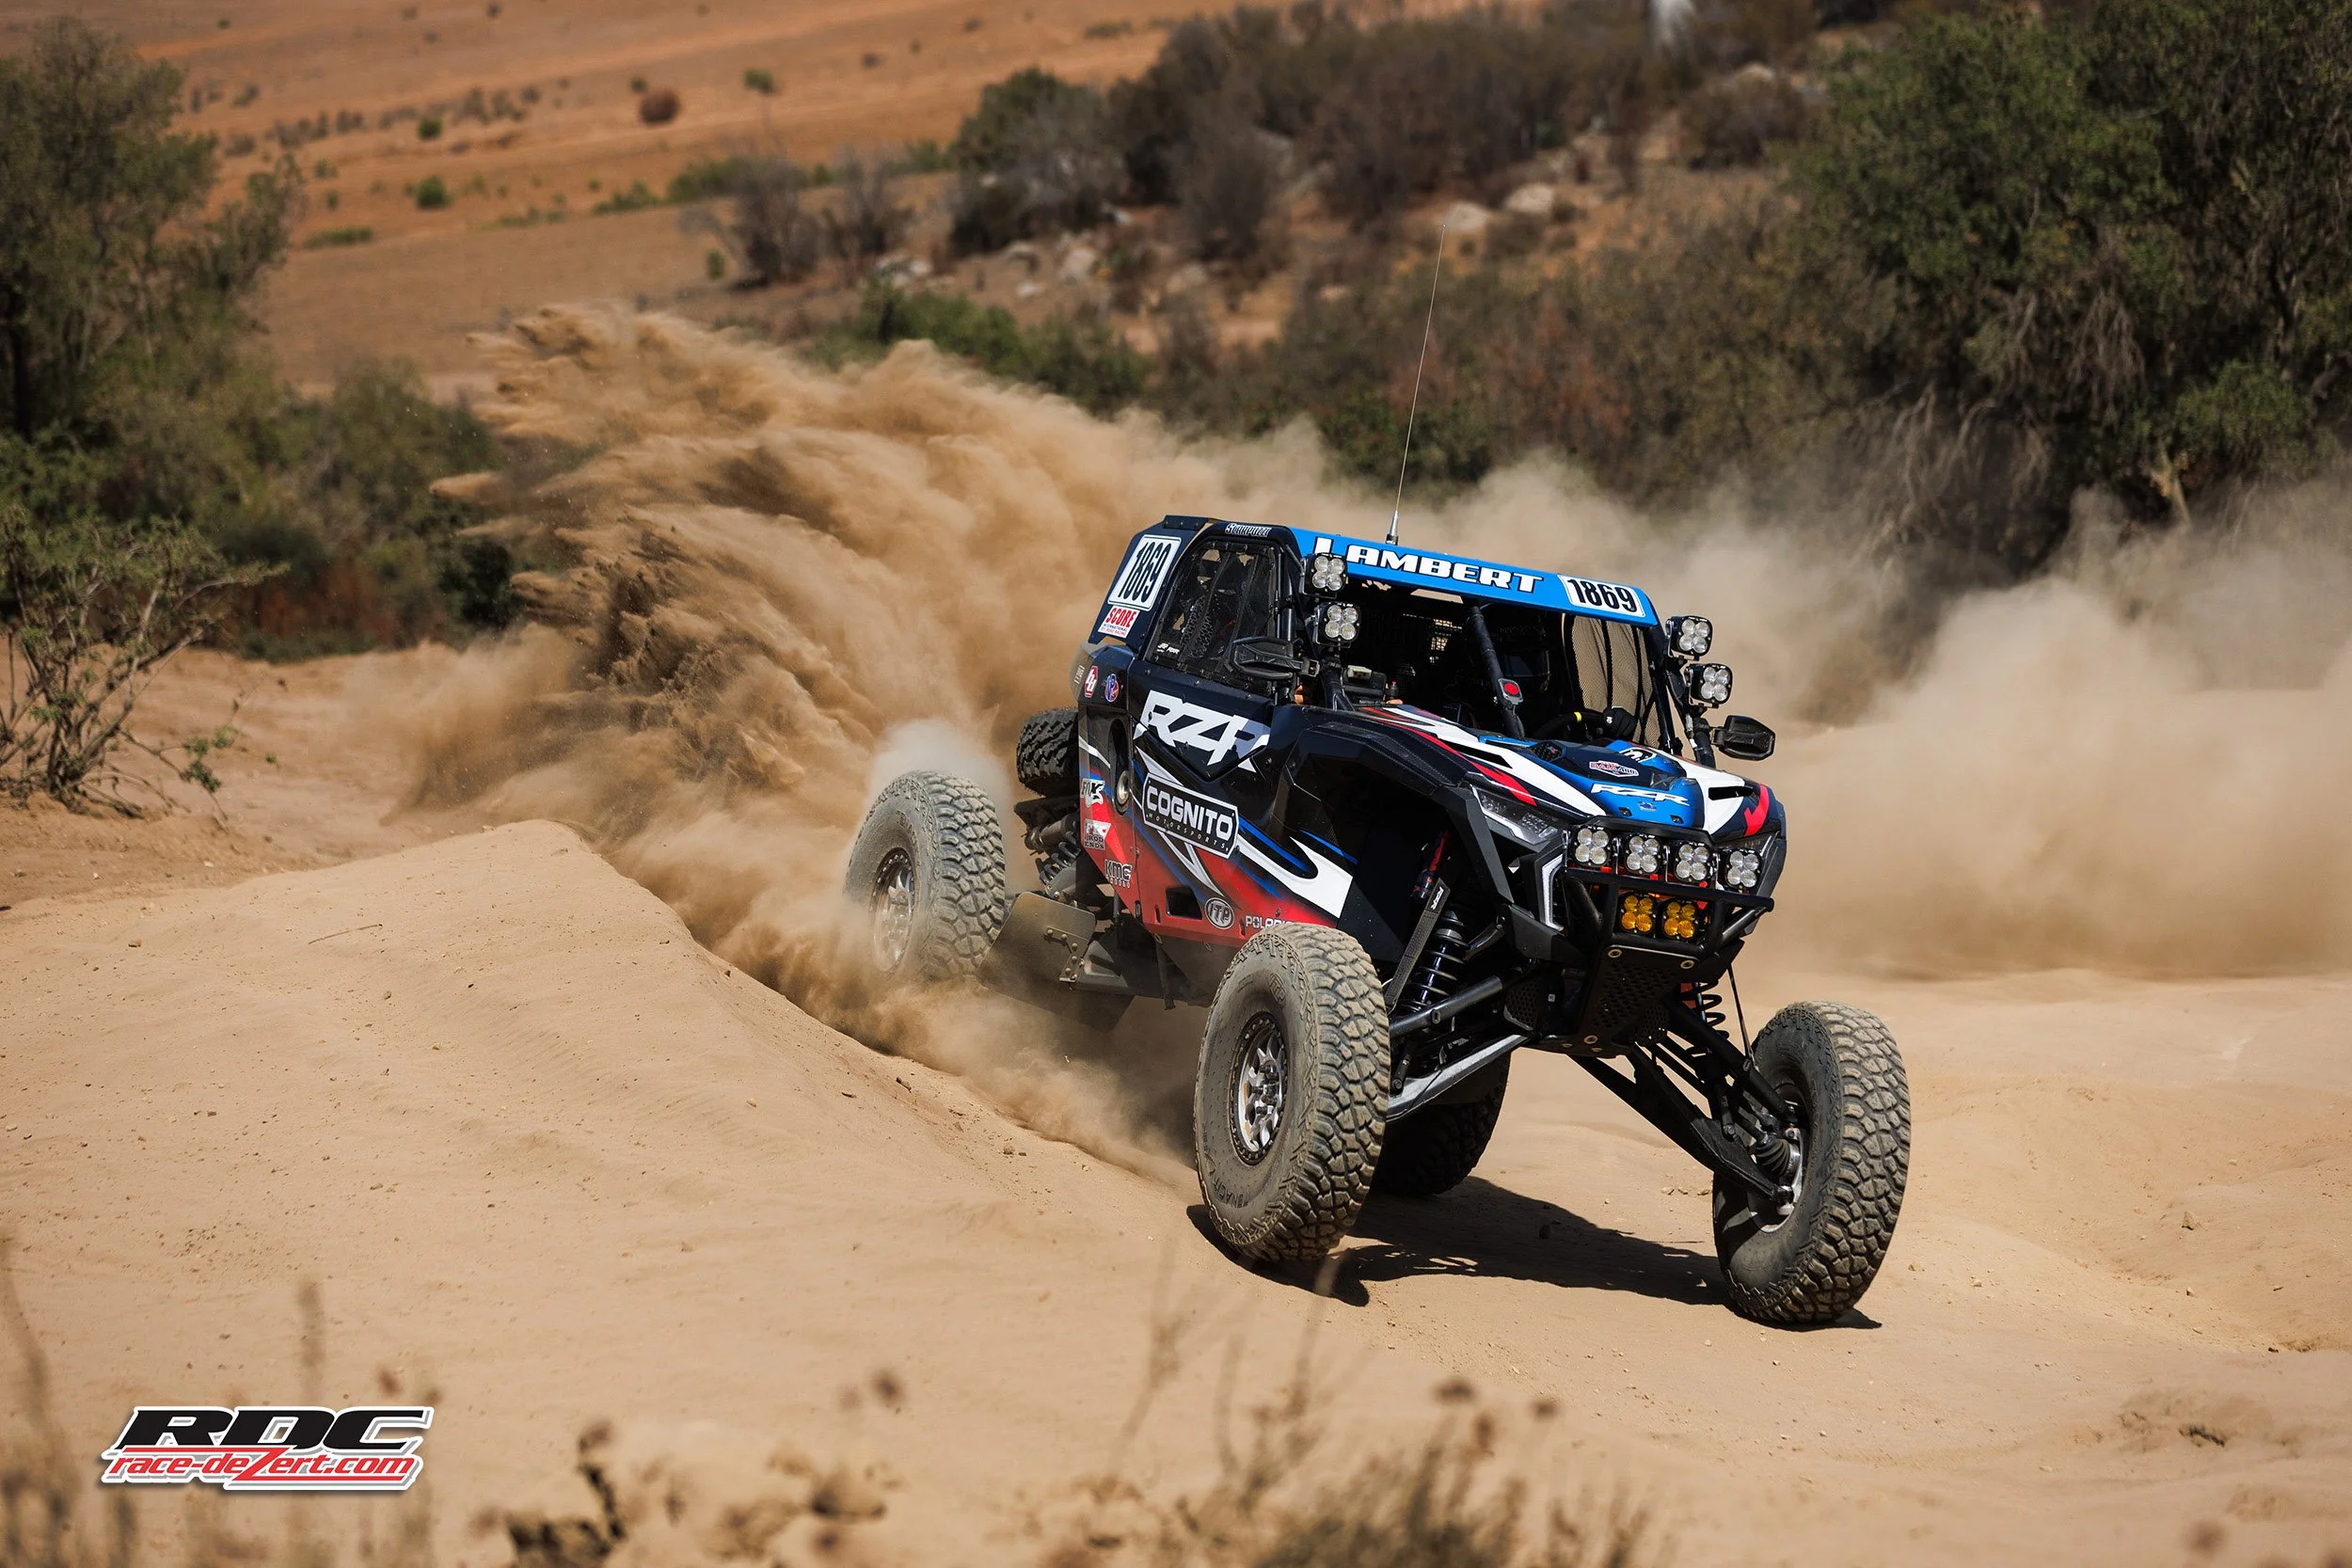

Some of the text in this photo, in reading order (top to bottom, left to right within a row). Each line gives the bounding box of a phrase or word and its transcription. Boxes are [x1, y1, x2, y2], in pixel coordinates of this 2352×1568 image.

[1117, 541, 1172, 603] 1869
[1314, 537, 1543, 594] LAMBERT
[1566, 578, 1638, 613] 1869
[1105, 608, 1136, 628] SCORE
[1133, 689, 1271, 773] RZR
[1591, 783, 1691, 807] RZR
[1147, 785, 1233, 842] COGNITO
[1148, 813, 1227, 849] MOTORSPORTS
[1104, 859, 1133, 882] KMC
[1208, 902, 1232, 926] ITP
[1245, 914, 1294, 929] POLAR
